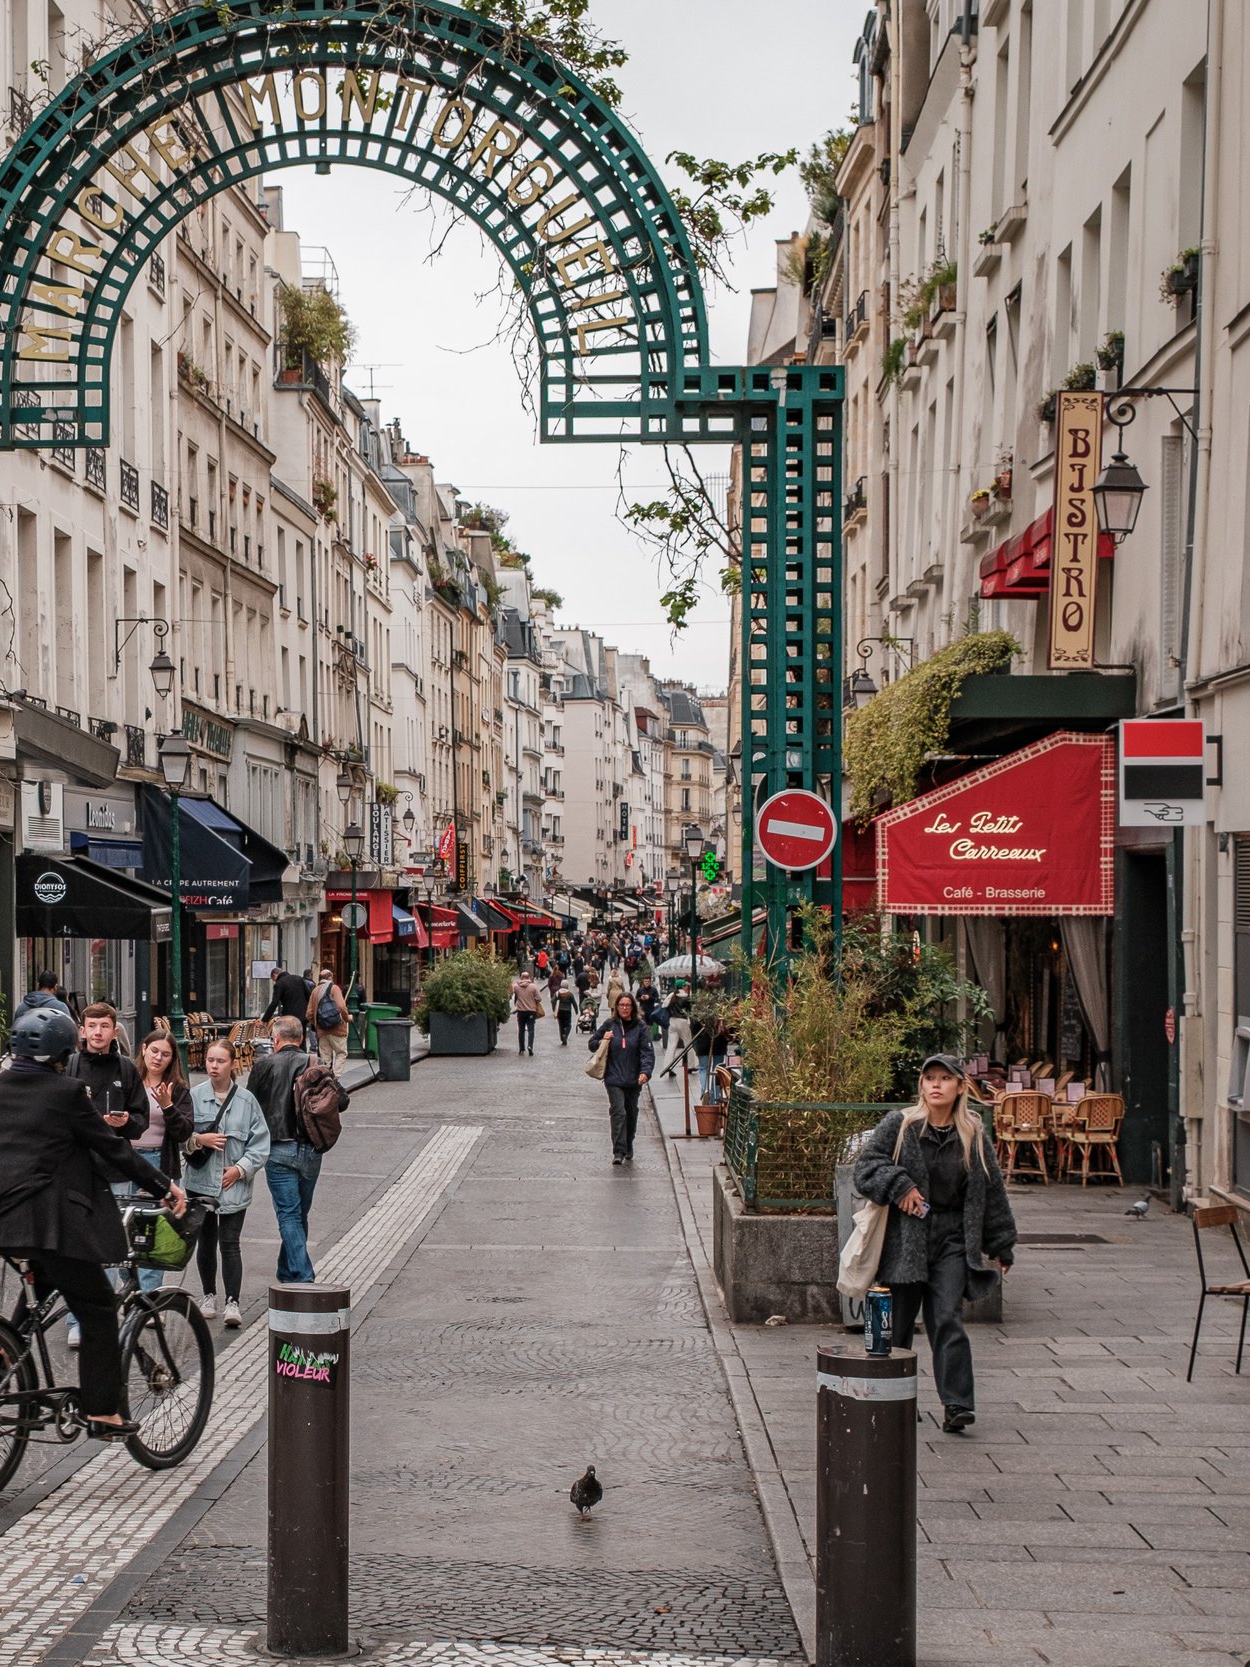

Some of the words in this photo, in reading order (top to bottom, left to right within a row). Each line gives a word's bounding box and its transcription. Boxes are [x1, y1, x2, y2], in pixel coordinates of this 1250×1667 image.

[19, 112, 193, 361] MARCHE
[240, 69, 627, 355] MONTORGUEIL
[1062, 428, 1091, 632] BISTRO
[88, 801, 116, 830] Leonidas
[924, 812, 962, 834] Les
[969, 811, 1024, 834] Petits
[948, 838, 1047, 862] Carreaux
[34, 883, 67, 891] DIONYSOS
[943, 885, 973, 899] Café
[985, 886, 1046, 899] Brasserie
[276, 1360, 331, 1383] VIOLEUR
